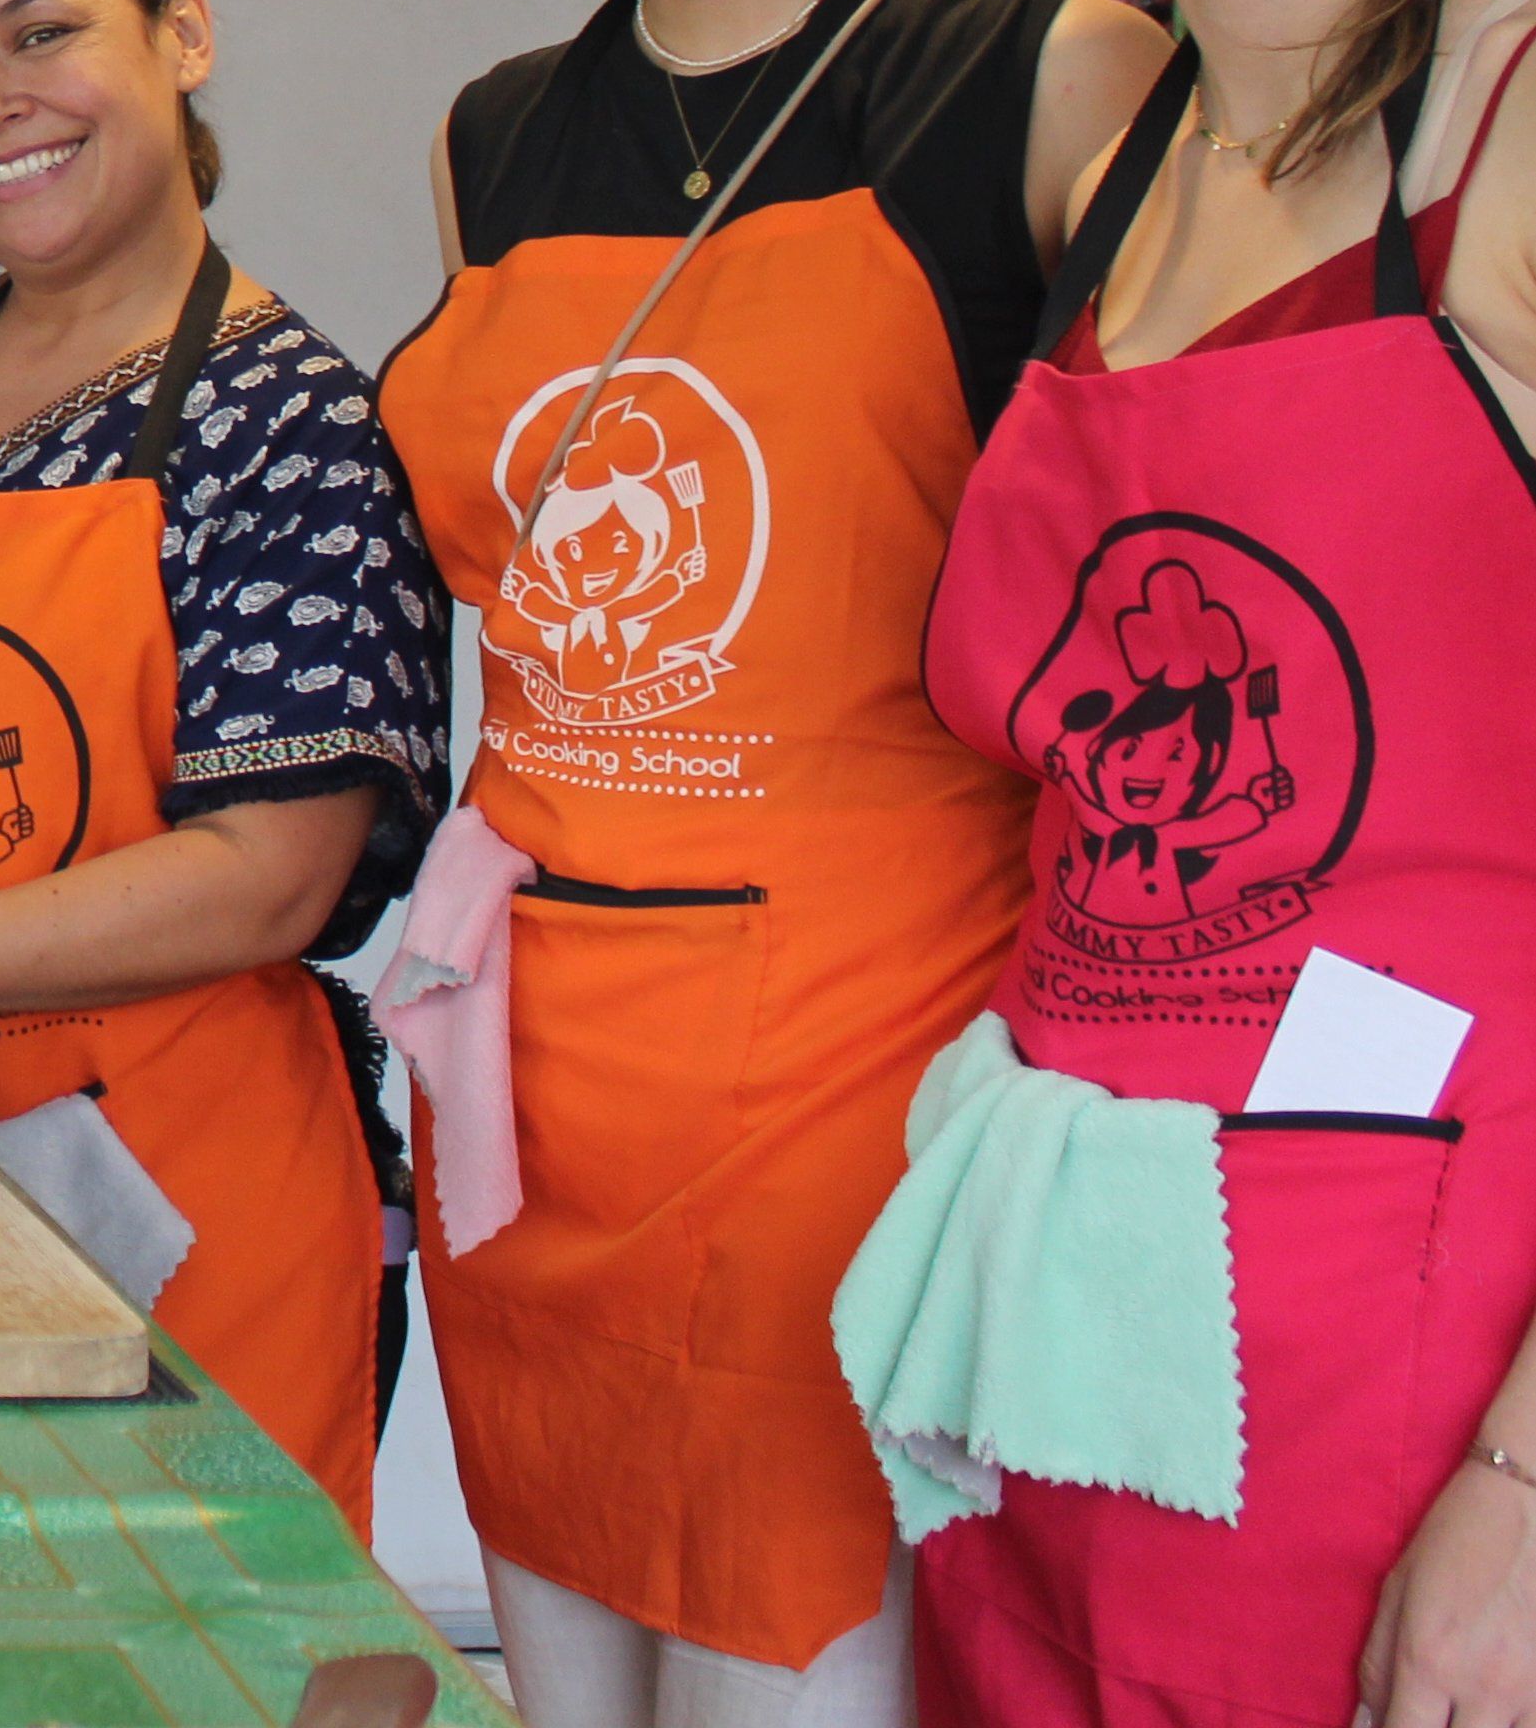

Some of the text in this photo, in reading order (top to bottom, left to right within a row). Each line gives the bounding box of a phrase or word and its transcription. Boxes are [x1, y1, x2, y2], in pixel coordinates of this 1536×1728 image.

[597, 673, 688, 721] TASTY
[512, 731, 620, 776] Cooking
[629, 745, 742, 779] School
[1162, 899, 1276, 956] TASTY
